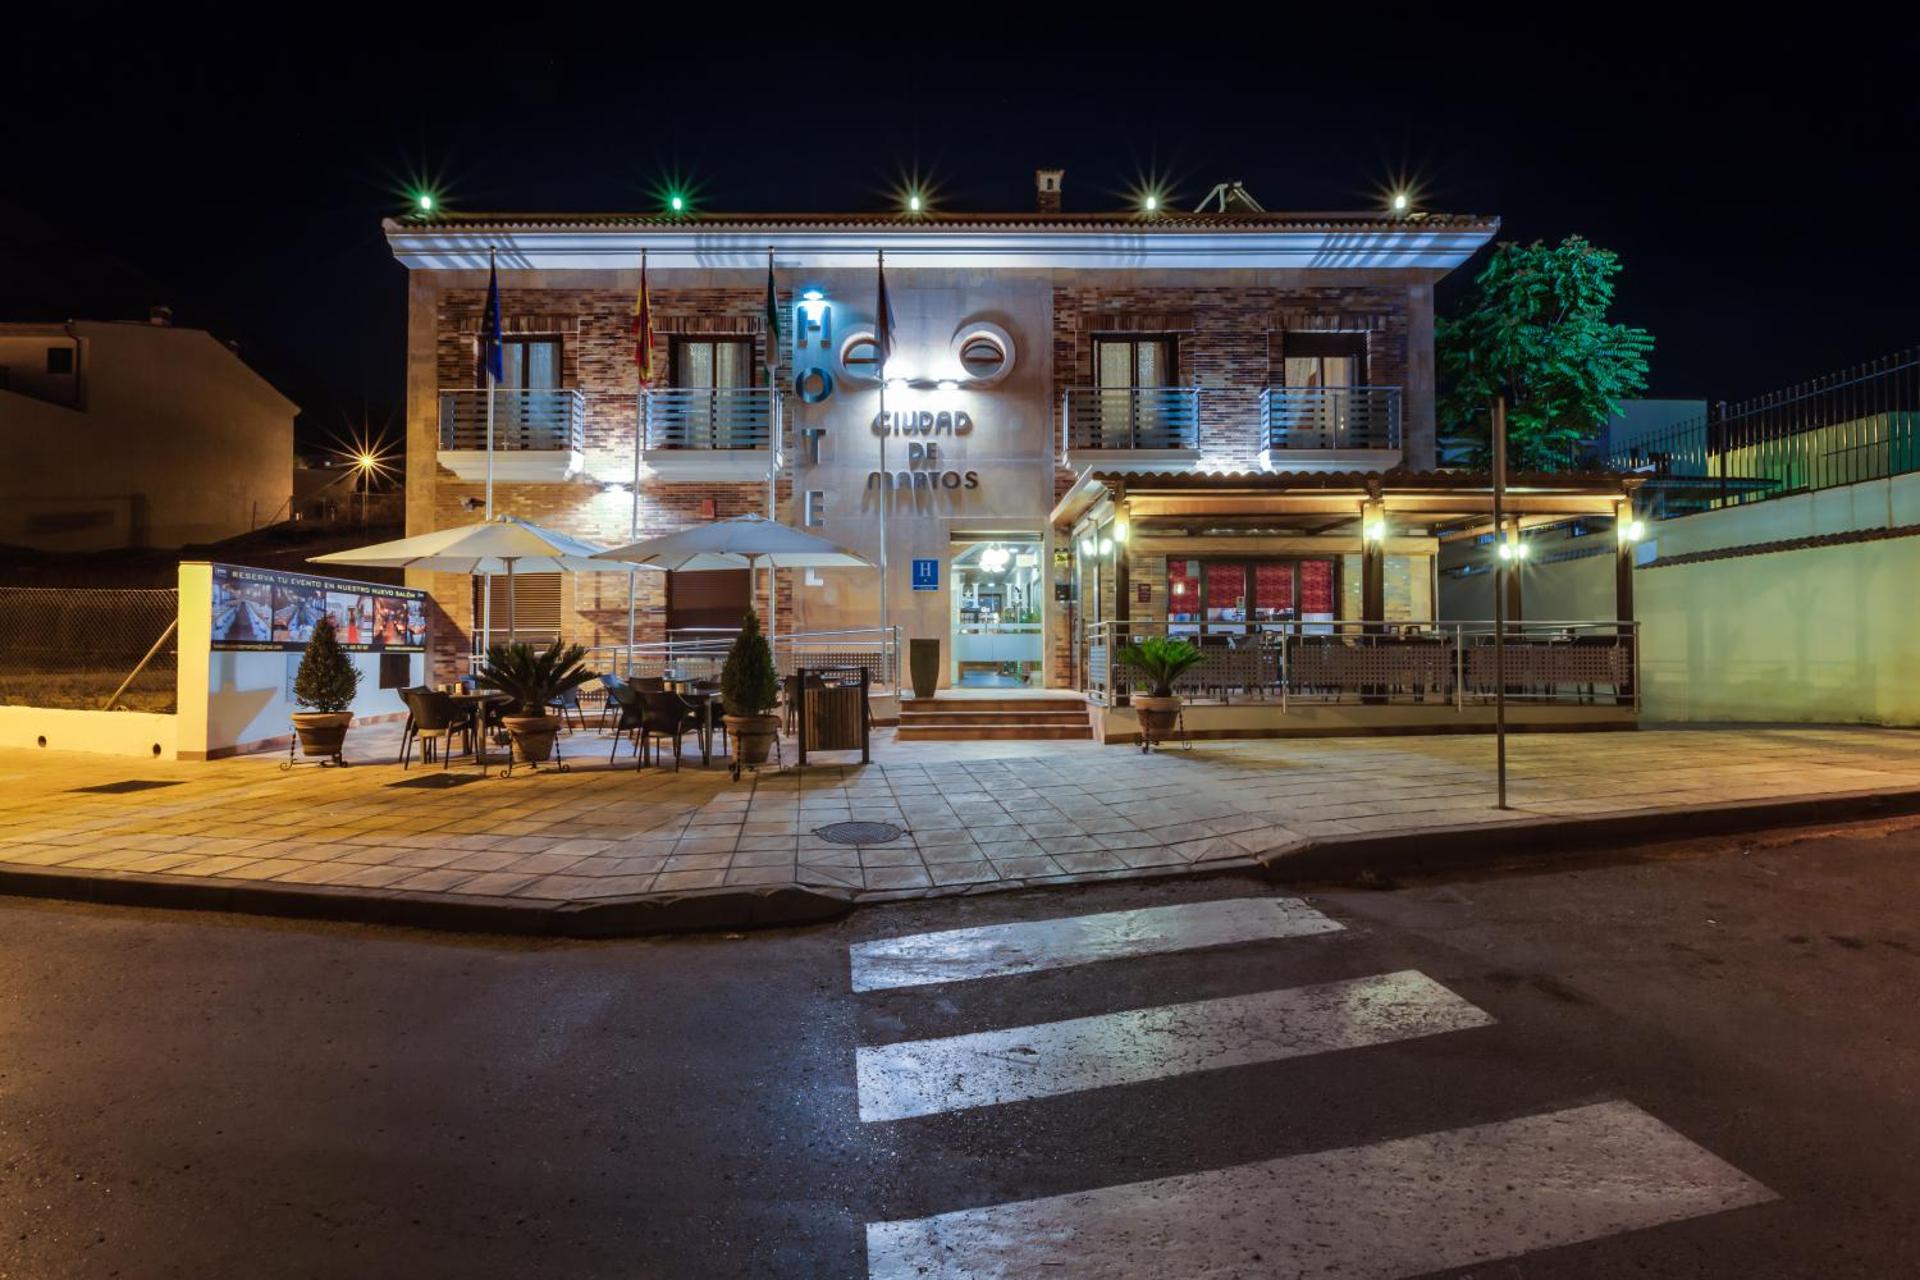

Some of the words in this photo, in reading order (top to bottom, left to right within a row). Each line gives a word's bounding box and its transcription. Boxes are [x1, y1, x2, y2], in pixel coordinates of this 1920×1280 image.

[871, 411, 973, 436] CIUDAD
[796, 301, 832, 586] HOTEL
[908, 442, 937, 460] DE
[867, 471, 978, 490] MARTOS
[920, 562, 931, 577] H
[232, 571, 275, 583] RESERVA
[277, 576, 288, 585] TU
[291, 578, 321, 588] EVENTO
[324, 582, 335, 590] EN
[337, 584, 370, 594] NUESTRO
[372, 588, 394, 597] NUEVO
